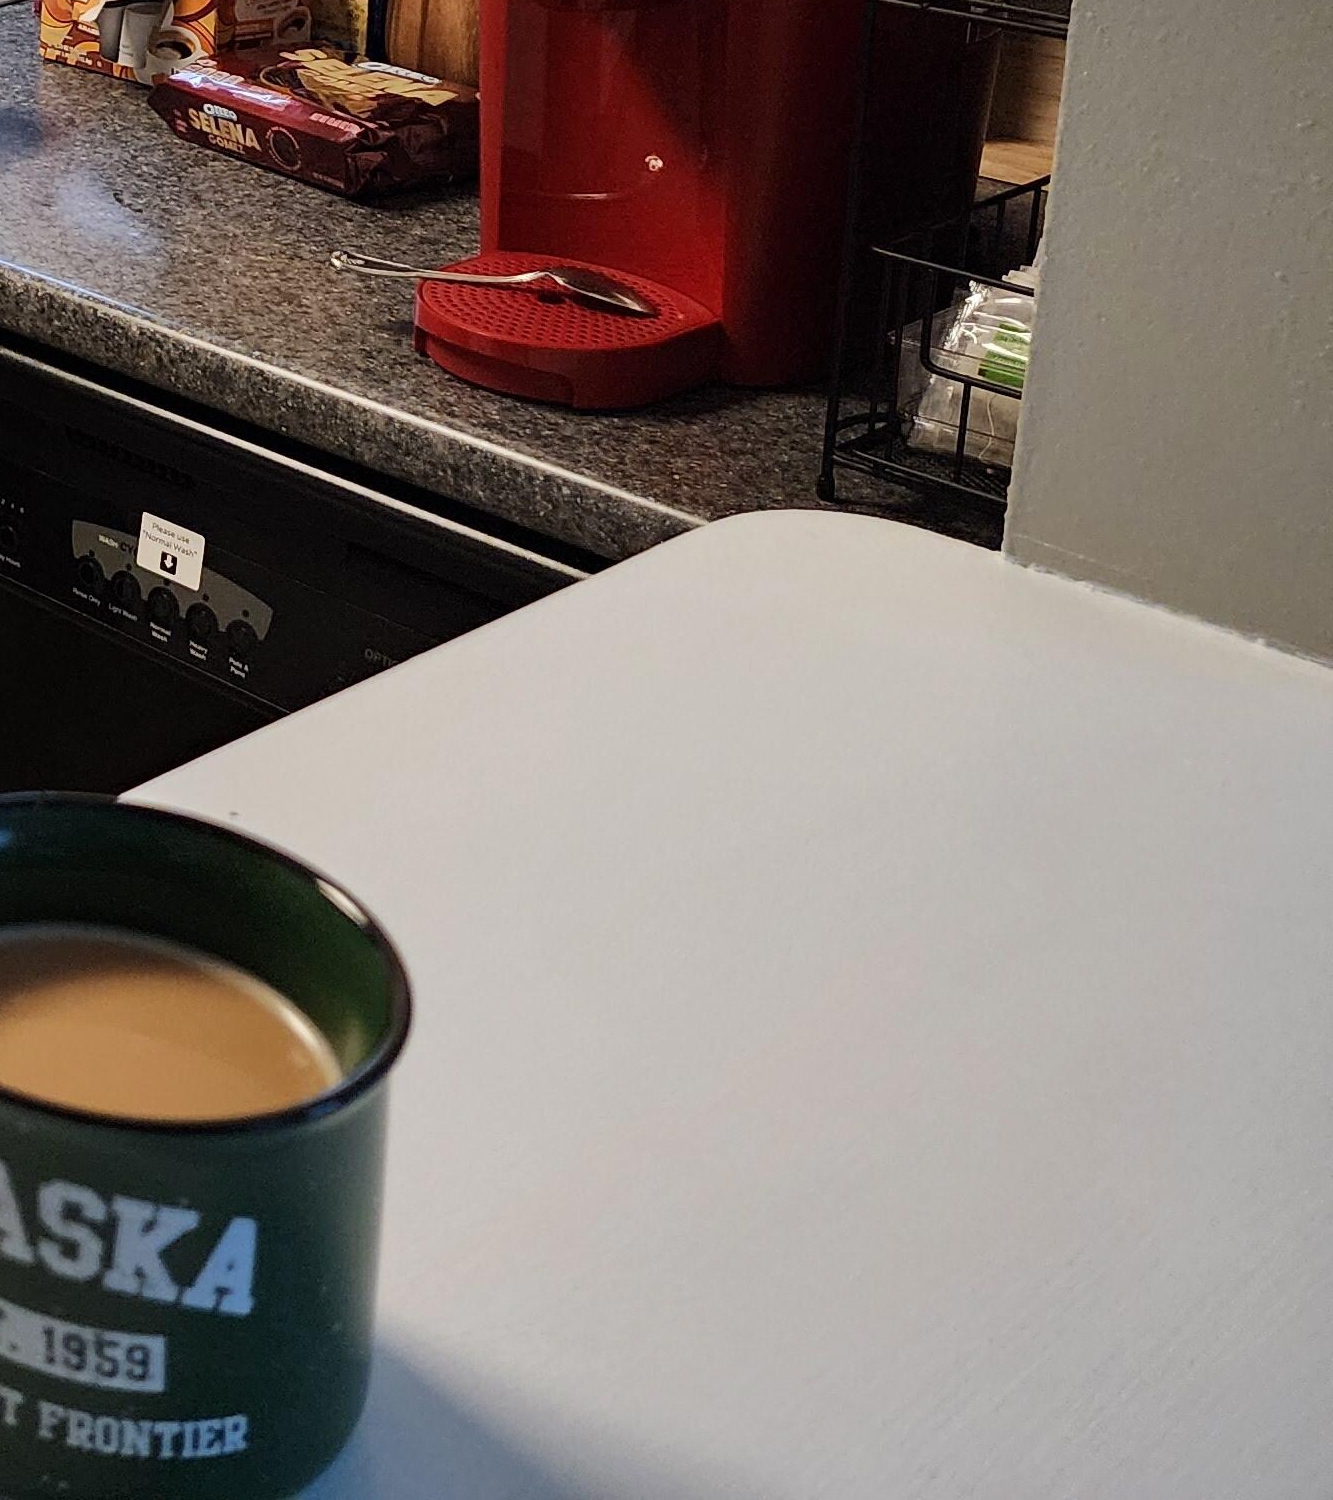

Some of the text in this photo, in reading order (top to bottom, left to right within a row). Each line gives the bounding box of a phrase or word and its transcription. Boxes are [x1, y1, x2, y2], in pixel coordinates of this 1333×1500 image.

[188, 108, 262, 153] SELENA
[142, 529, 198, 557] "Normal Wash"
[153, 522, 190, 545] Please use
[42, 1326, 151, 1382] 1959
[38, 1400, 249, 1460] FRONTIER
